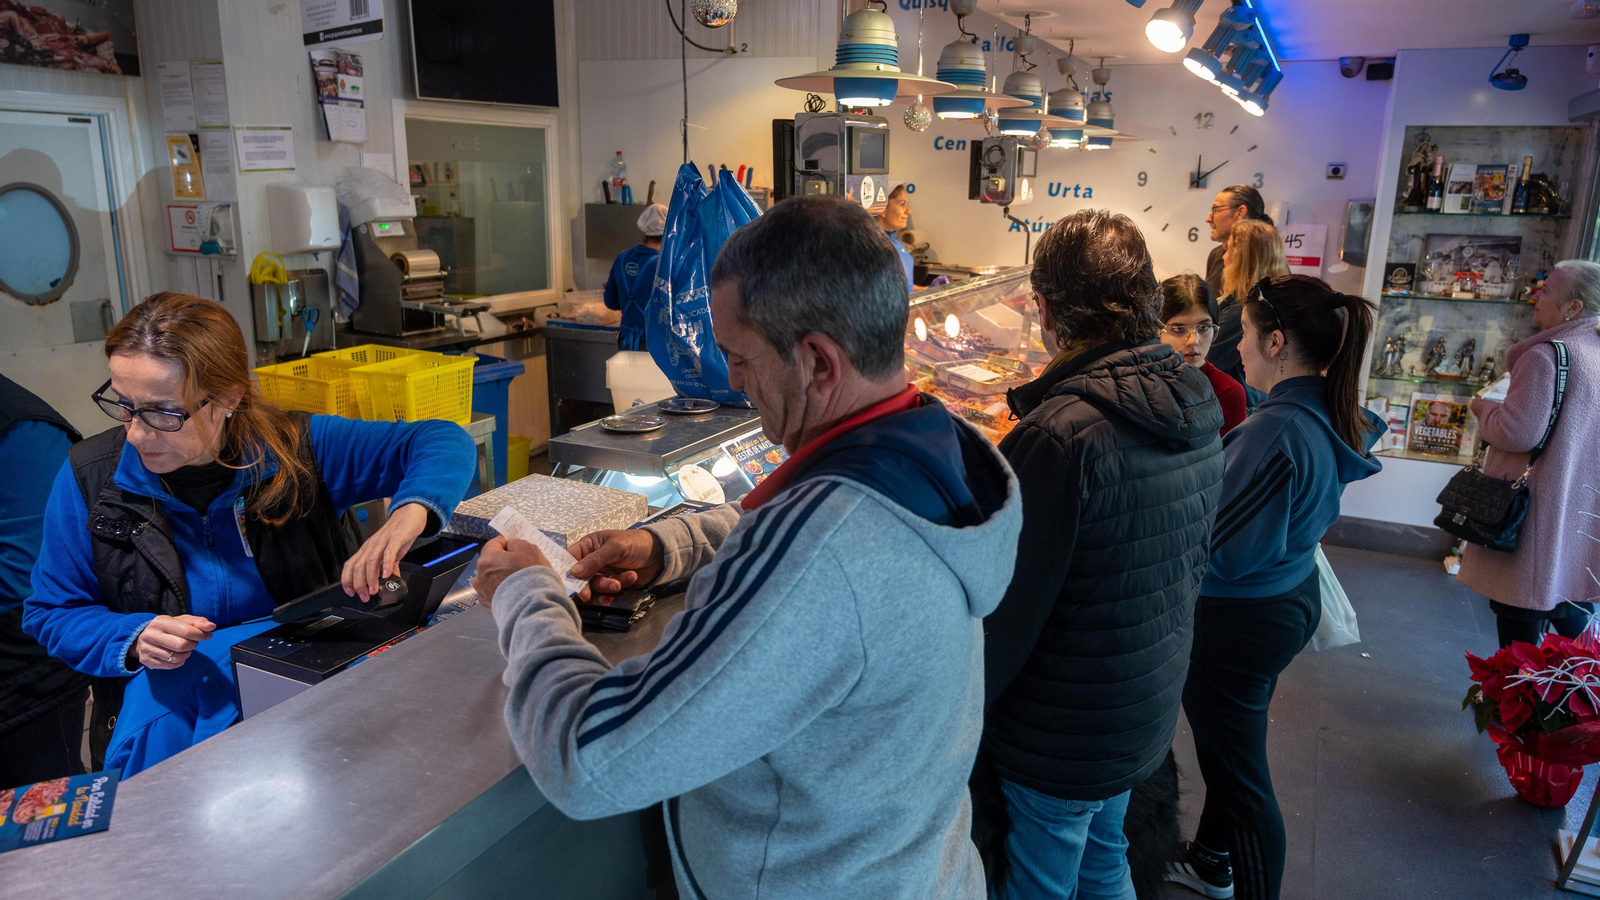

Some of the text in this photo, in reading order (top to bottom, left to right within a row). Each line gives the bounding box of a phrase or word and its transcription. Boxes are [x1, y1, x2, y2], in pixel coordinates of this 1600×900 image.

[741, 43, 748, 52] 2
[1194, 112, 1215, 129] 12
[1137, 171, 1148, 187] 9
[1253, 172, 1264, 188] 3
[1048, 182, 1094, 199] Urta
[1188, 227, 1199, 242] 6
[1559, 370, 1567, 392] GUESS
[1414, 425, 1458, 440] VEGETABLES
[736, 449, 755, 461] CESTAS
[751, 445, 760, 454] DE
